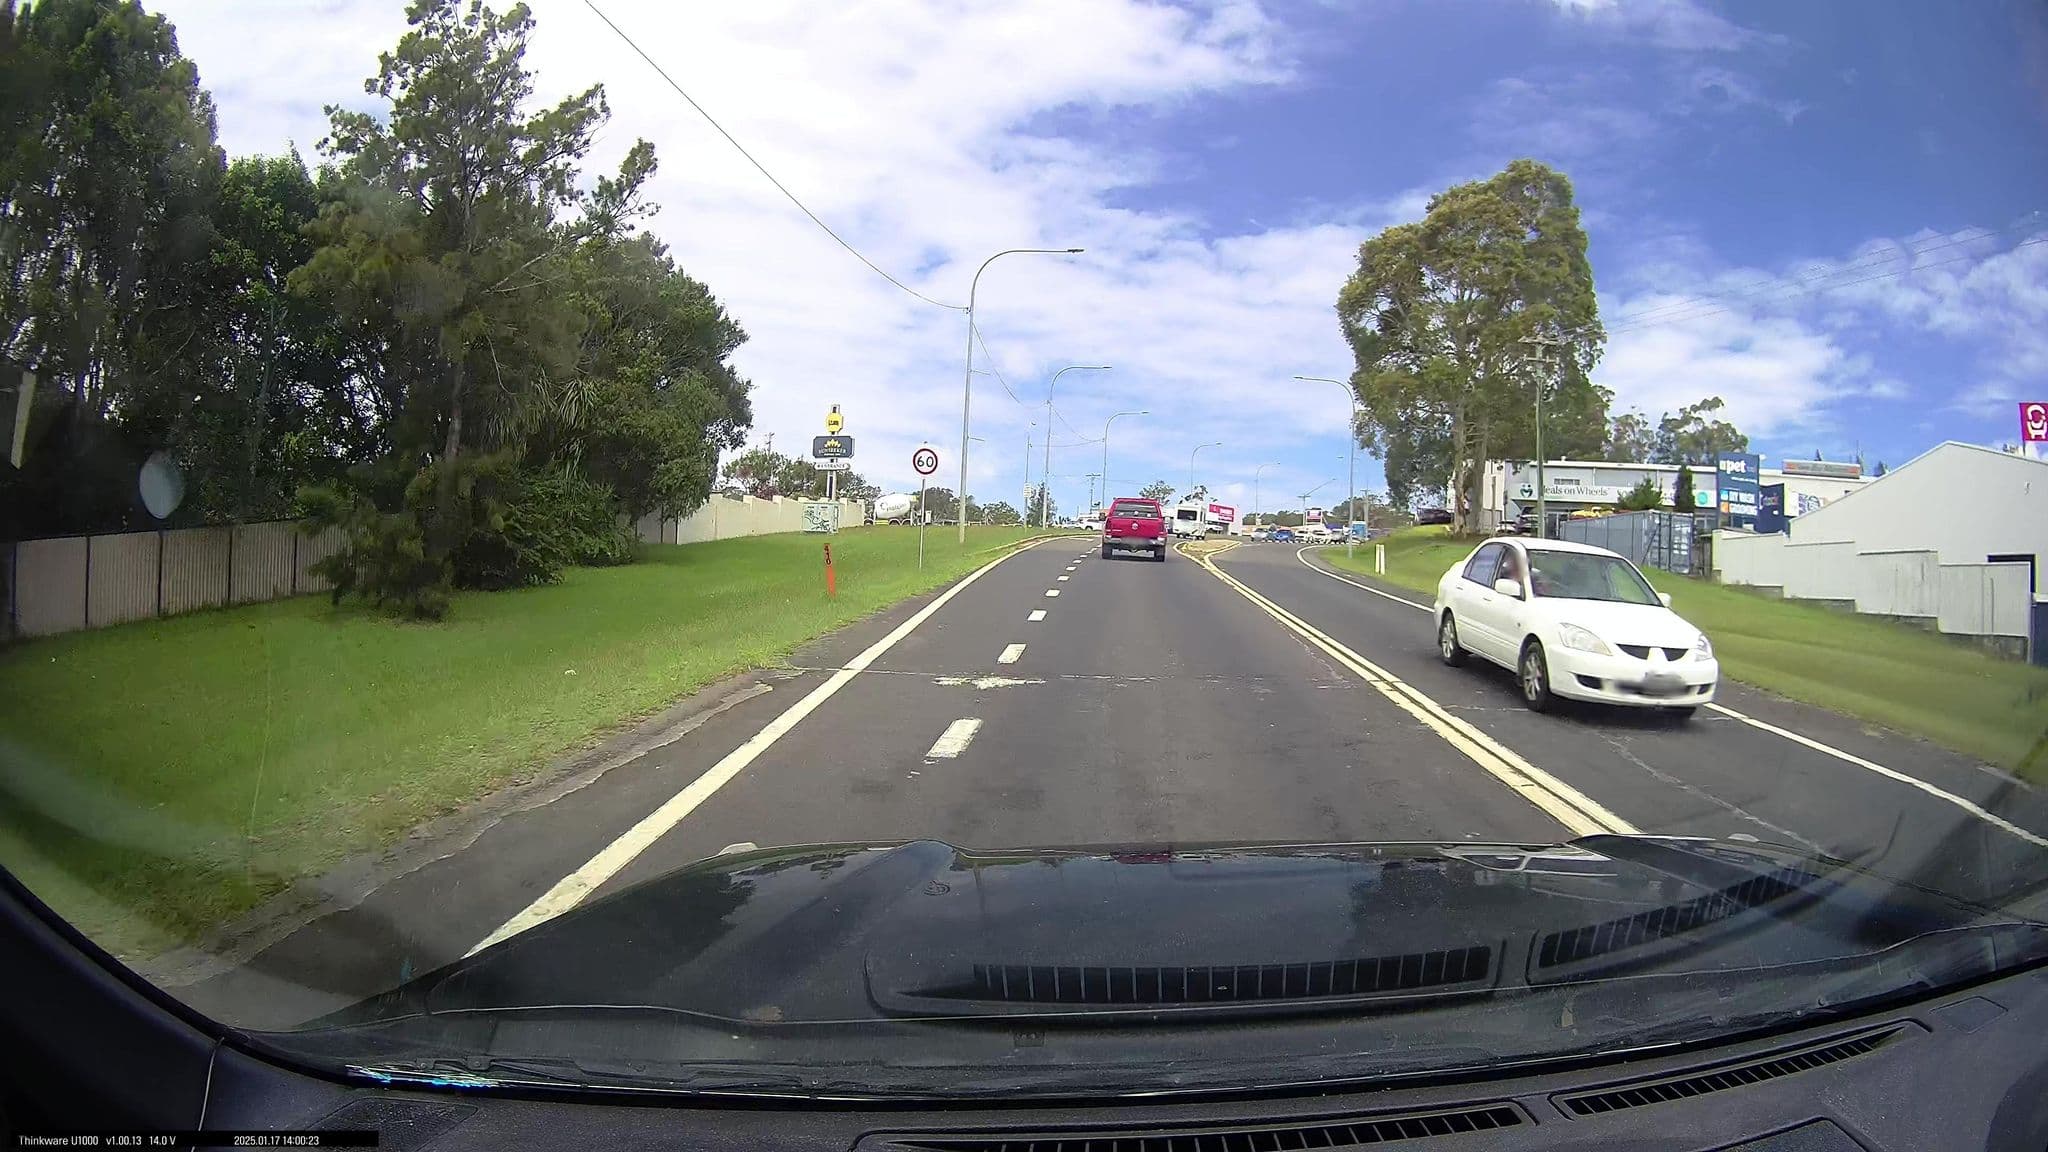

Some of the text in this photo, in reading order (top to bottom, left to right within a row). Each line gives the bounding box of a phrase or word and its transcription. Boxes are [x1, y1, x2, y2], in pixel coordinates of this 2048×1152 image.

[917, 455, 934, 468] 60
[1726, 459, 1746, 475] pet
[1543, 485, 1562, 495] eals
[1564, 487, 1575, 495] on
[1575, 486, 1608, 496] Wheels
